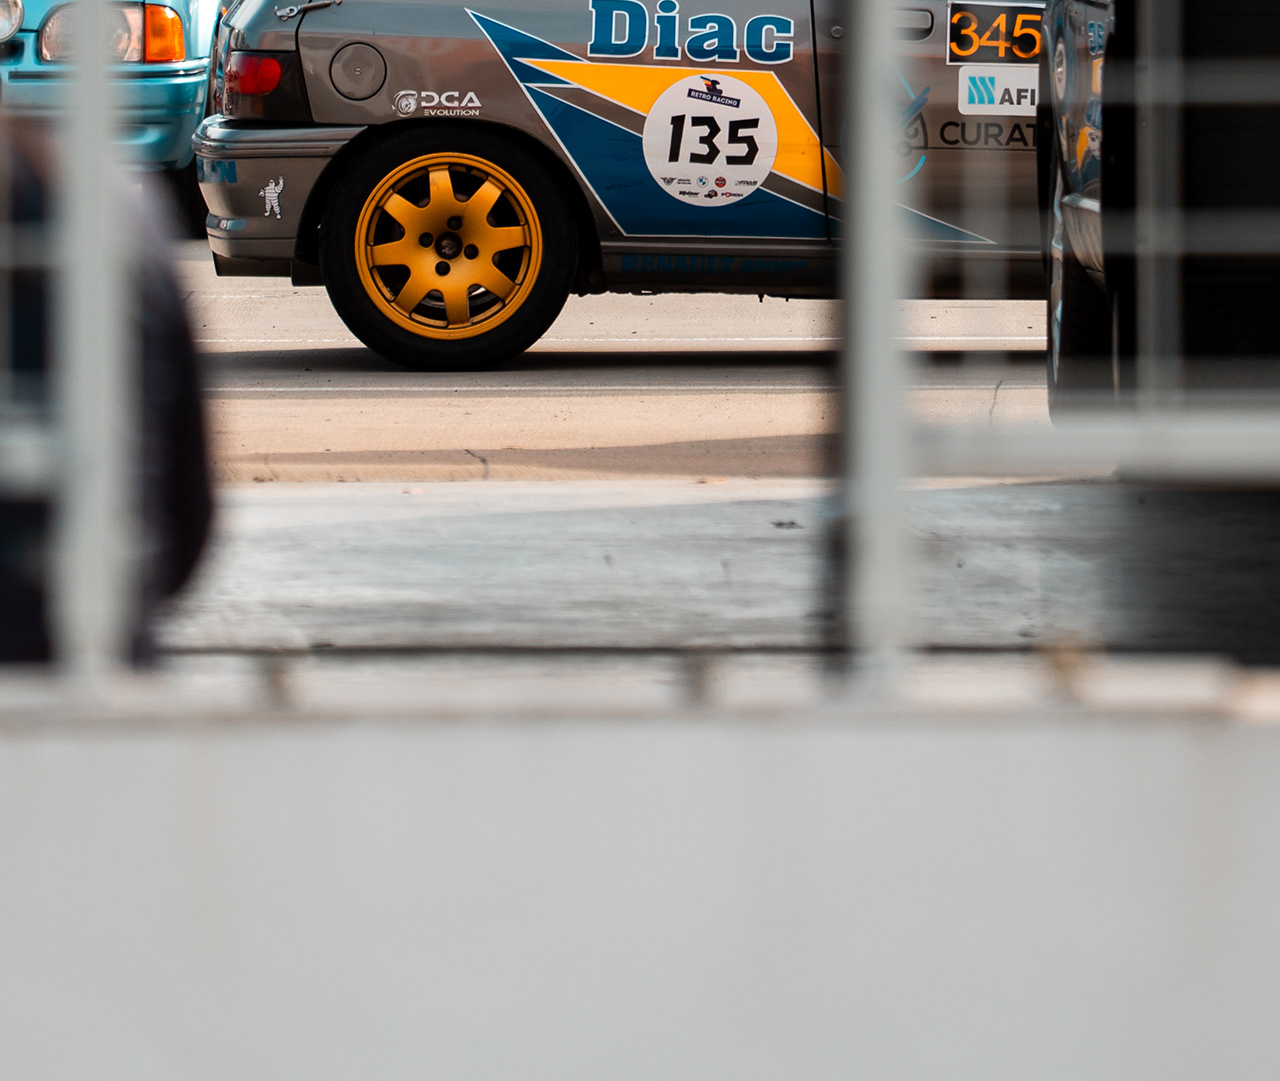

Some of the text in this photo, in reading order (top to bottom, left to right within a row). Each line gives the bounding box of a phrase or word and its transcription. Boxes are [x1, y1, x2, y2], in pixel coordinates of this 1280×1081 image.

[949, 11, 1042, 59] 345
[421, 91, 482, 107] DCA
[690, 90, 738, 107] RETRO RACING
[999, 88, 1036, 106] AFI
[668, 114, 760, 165] 135
[621, 254, 735, 274] RENAULT
